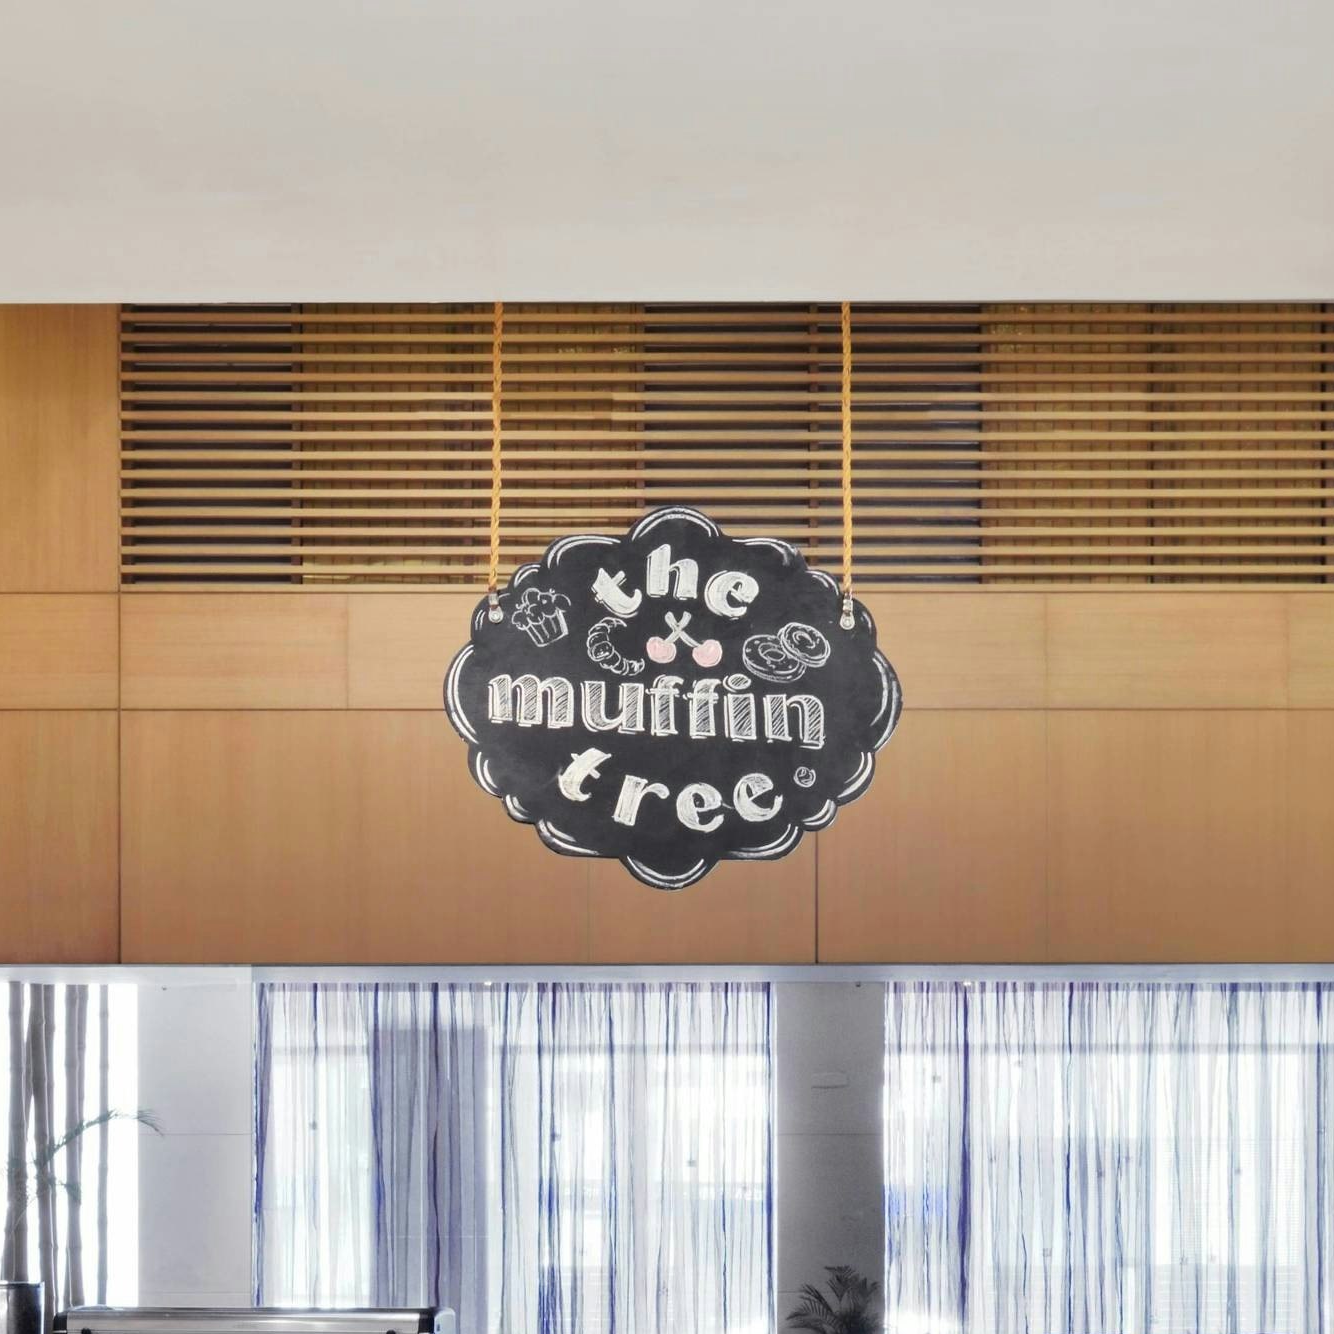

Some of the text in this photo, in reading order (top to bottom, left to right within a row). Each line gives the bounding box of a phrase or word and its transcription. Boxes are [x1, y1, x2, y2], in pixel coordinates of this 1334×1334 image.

[590, 543, 760, 619] the
[487, 673, 827, 748] muffin
[558, 746, 783, 832] tree
